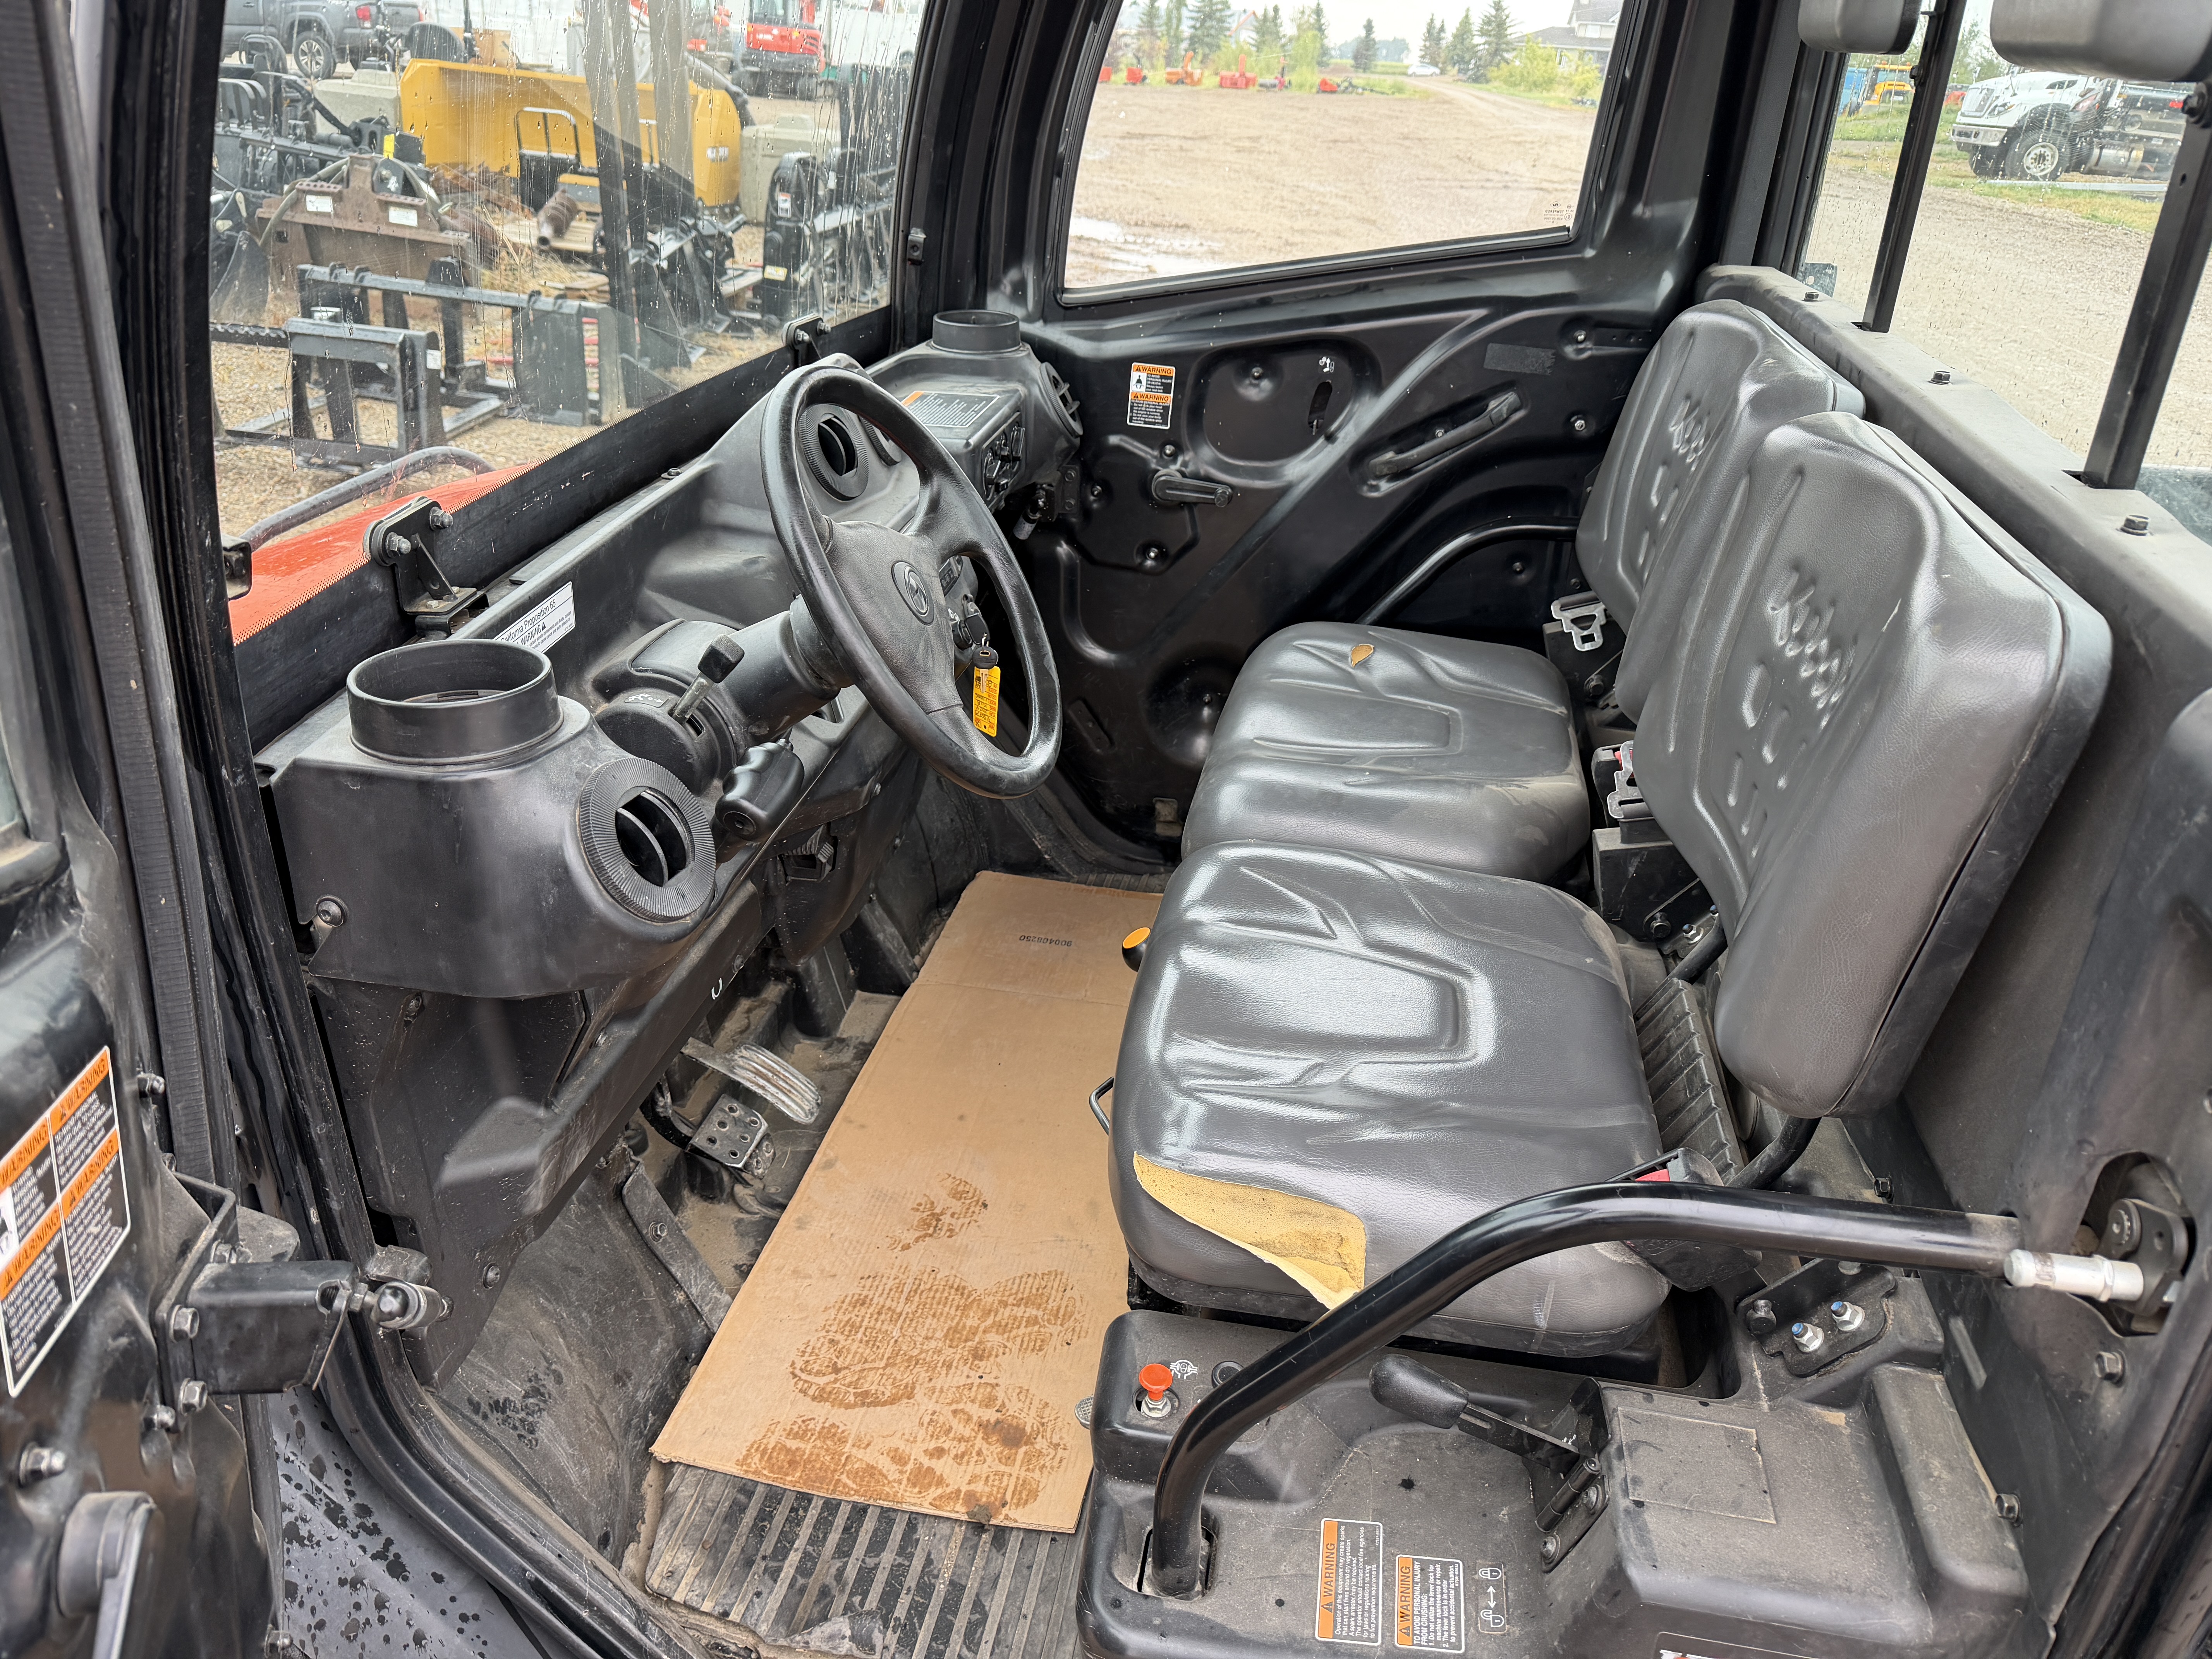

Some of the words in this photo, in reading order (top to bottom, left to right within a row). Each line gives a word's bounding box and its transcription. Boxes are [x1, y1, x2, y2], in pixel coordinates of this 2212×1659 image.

[1142, 366, 1171, 374] WARNING
[1139, 393, 1169, 401] WARNING
[524, 605, 549, 629] Proposition
[550, 599, 556, 609] 65
[520, 624, 541, 645] WARNING
[1019, 934, 1072, 947] 900408250
[66, 1058, 105, 1108] WARNING
[1, 1123, 47, 1184] WARNING
[76, 1140, 114, 1194] WARNING
[12, 1209, 59, 1277] WARNING
[1323, 1542, 1335, 1597] WARNING
[1400, 1566, 1410, 1623] WARNING
[1413, 1635, 1420, 1644] TO
